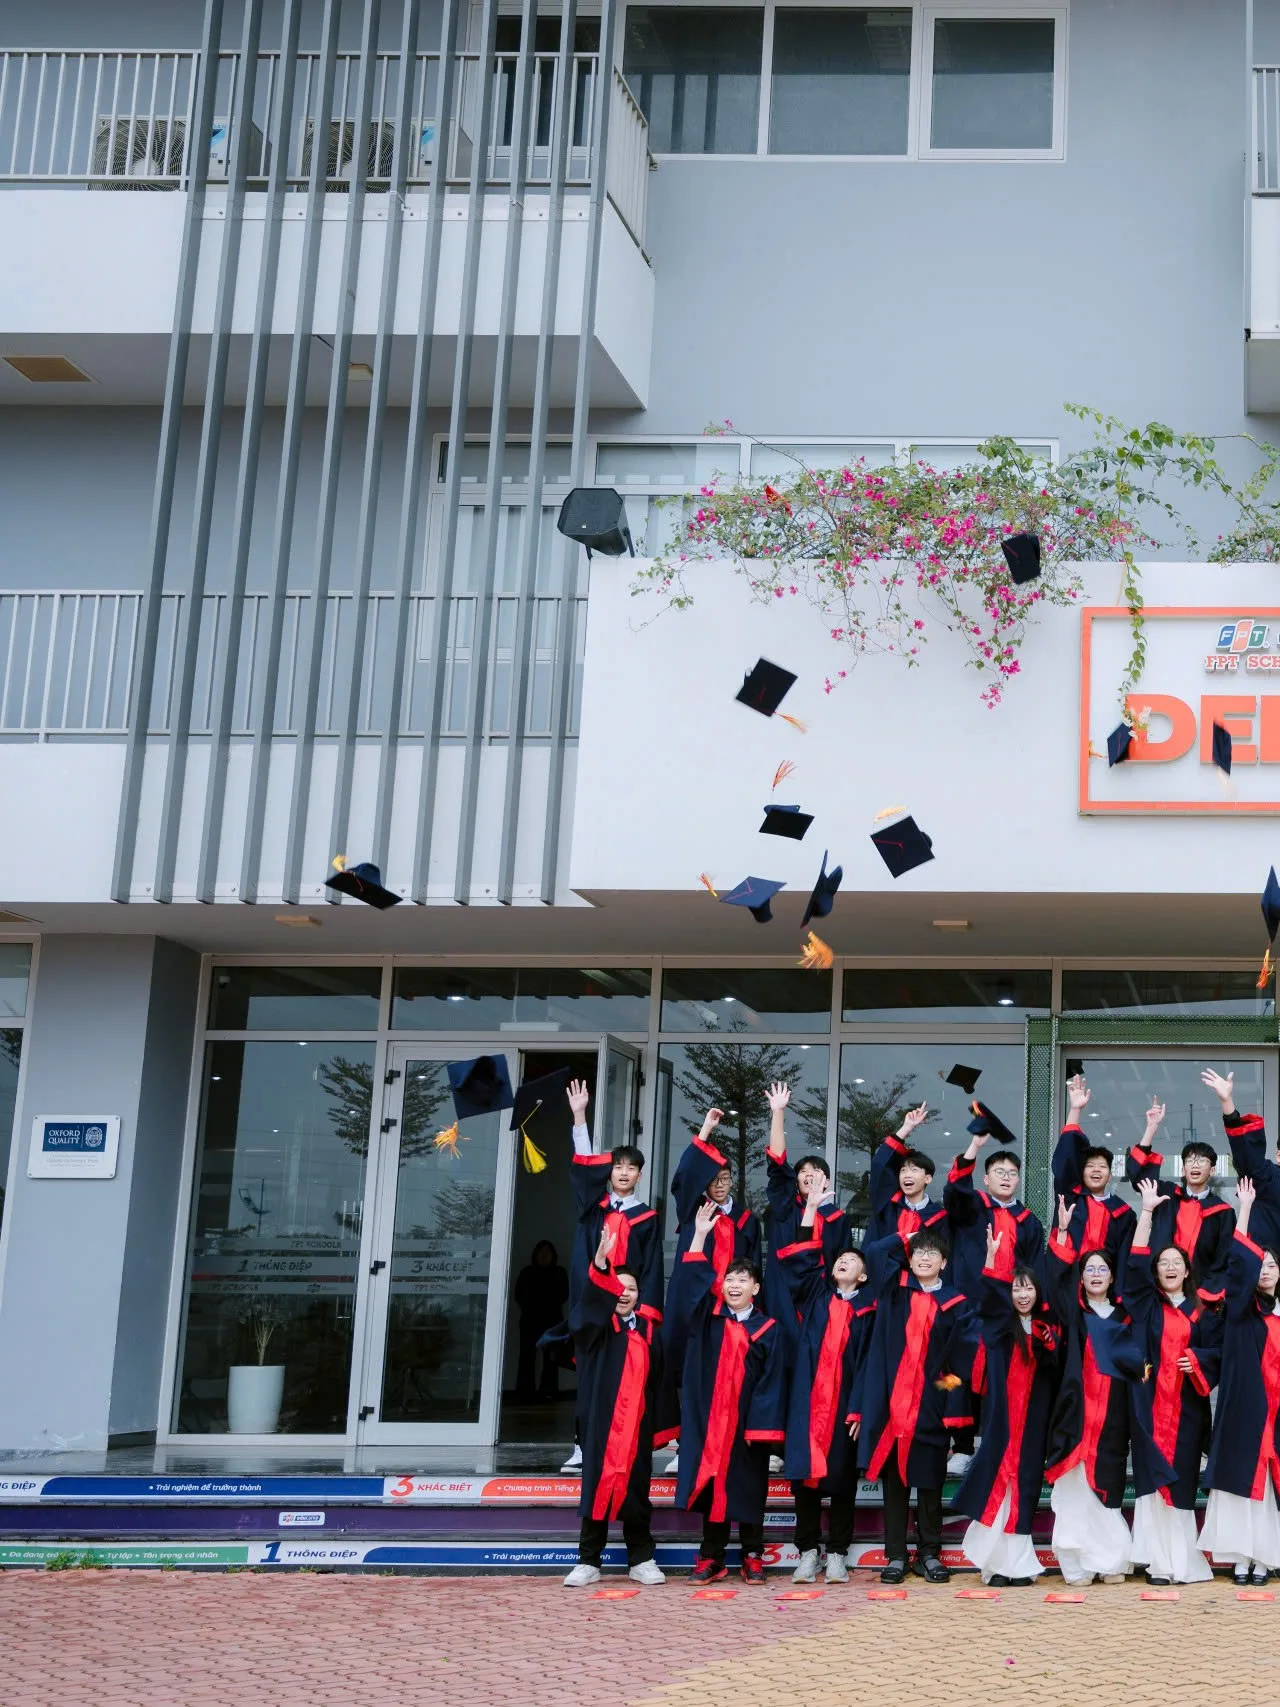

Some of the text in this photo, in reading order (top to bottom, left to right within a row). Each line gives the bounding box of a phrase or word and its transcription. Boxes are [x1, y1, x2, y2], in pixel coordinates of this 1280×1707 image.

[1206, 655, 1238, 668] FPT
[48, 1129, 80, 1137] OXFORD
[48, 1137, 80, 1146] QUALITY
[11, 1481, 37, 1490] ĐIỆP
[171, 1484, 200, 1492] nghiệm
[200, 1482, 212, 1491] để
[239, 1483, 262, 1491] thành
[390, 1475, 473, 1497] 3 KHÁC BIỆT
[503, 1484, 533, 1492] Chương
[554, 1484, 575, 1493] Tiếng
[260, 1541, 358, 1563] 1 THÔNG ĐIỆP
[509, 1552, 541, 1562] nghiệm
[542, 1552, 555, 1560] để
